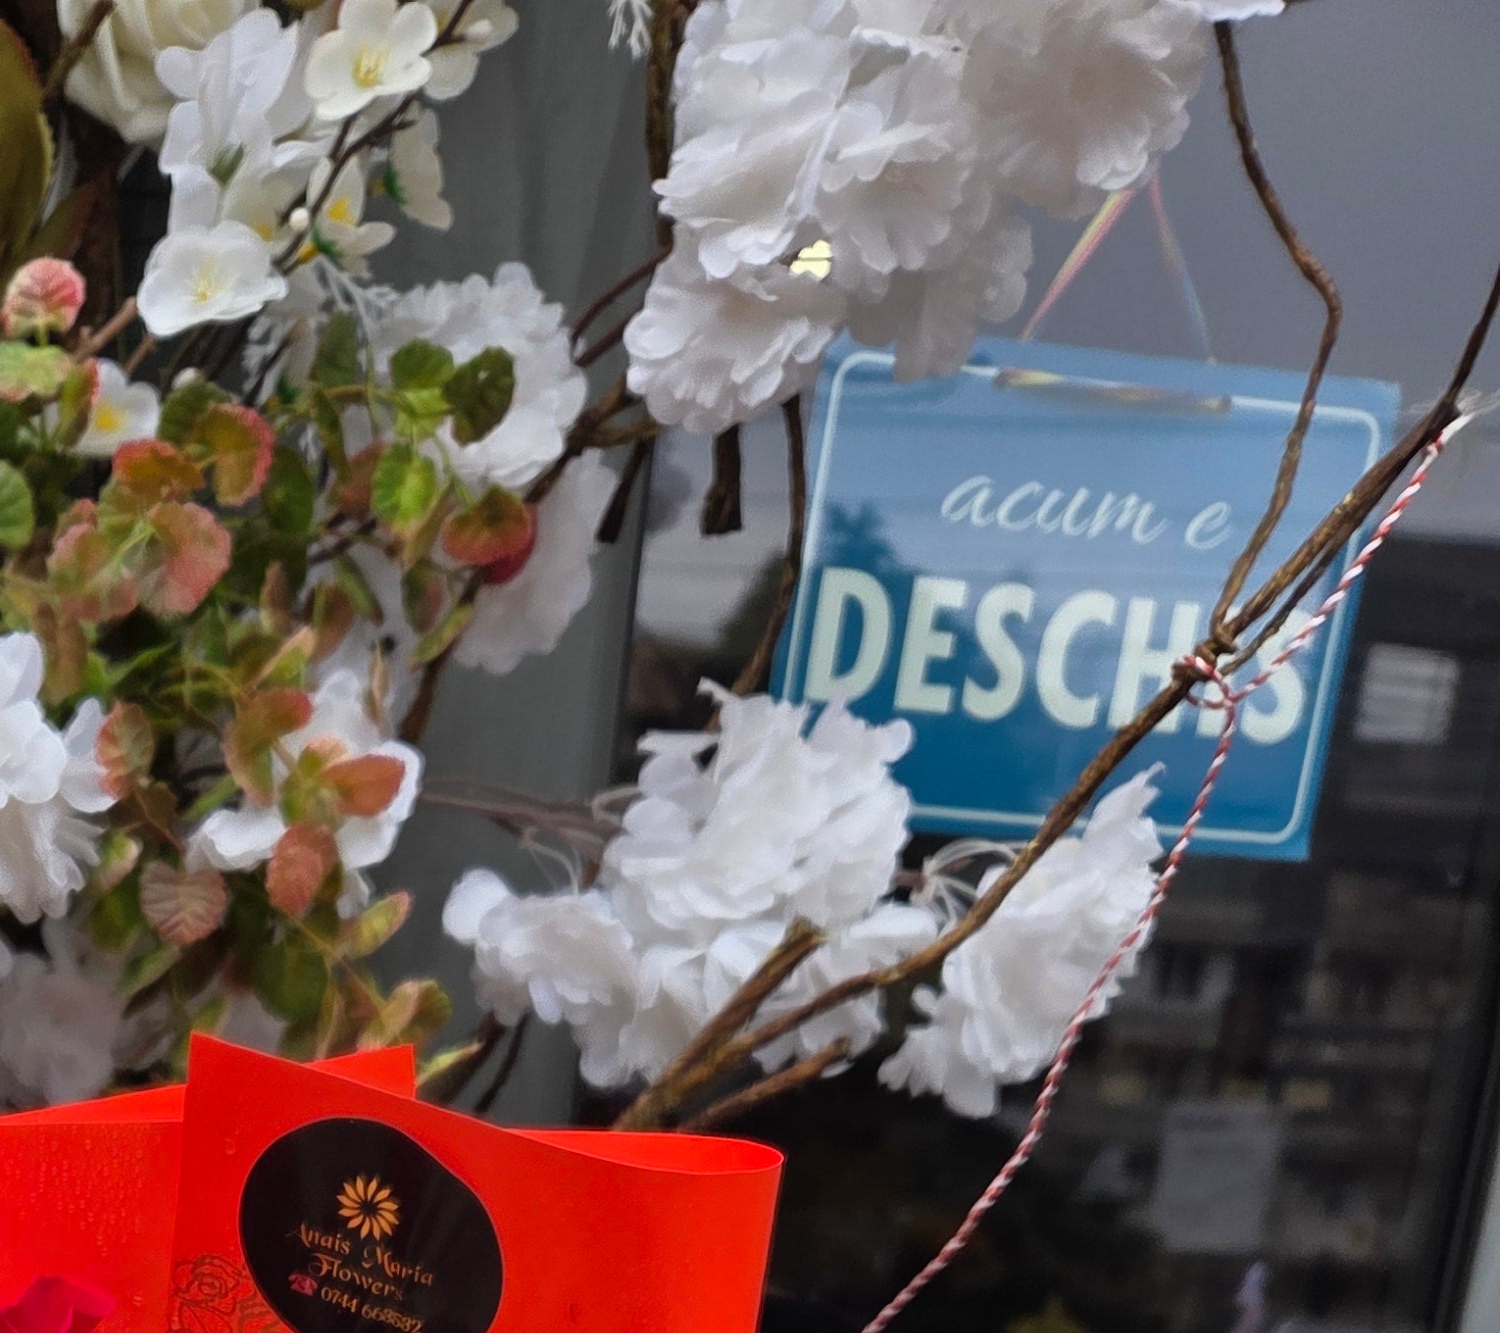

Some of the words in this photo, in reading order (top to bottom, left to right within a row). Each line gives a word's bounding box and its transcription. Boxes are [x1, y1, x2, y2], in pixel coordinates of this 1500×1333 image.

[940, 474, 1168, 545] acum
[1183, 500, 1235, 550] e
[804, 566, 1315, 746] DESCHIS
[284, 1221, 350, 1255] Anais
[362, 1245, 435, 1288] Maria
[308, 1252, 404, 1301] Flowers
[321, 1286, 359, 1314] 0744
